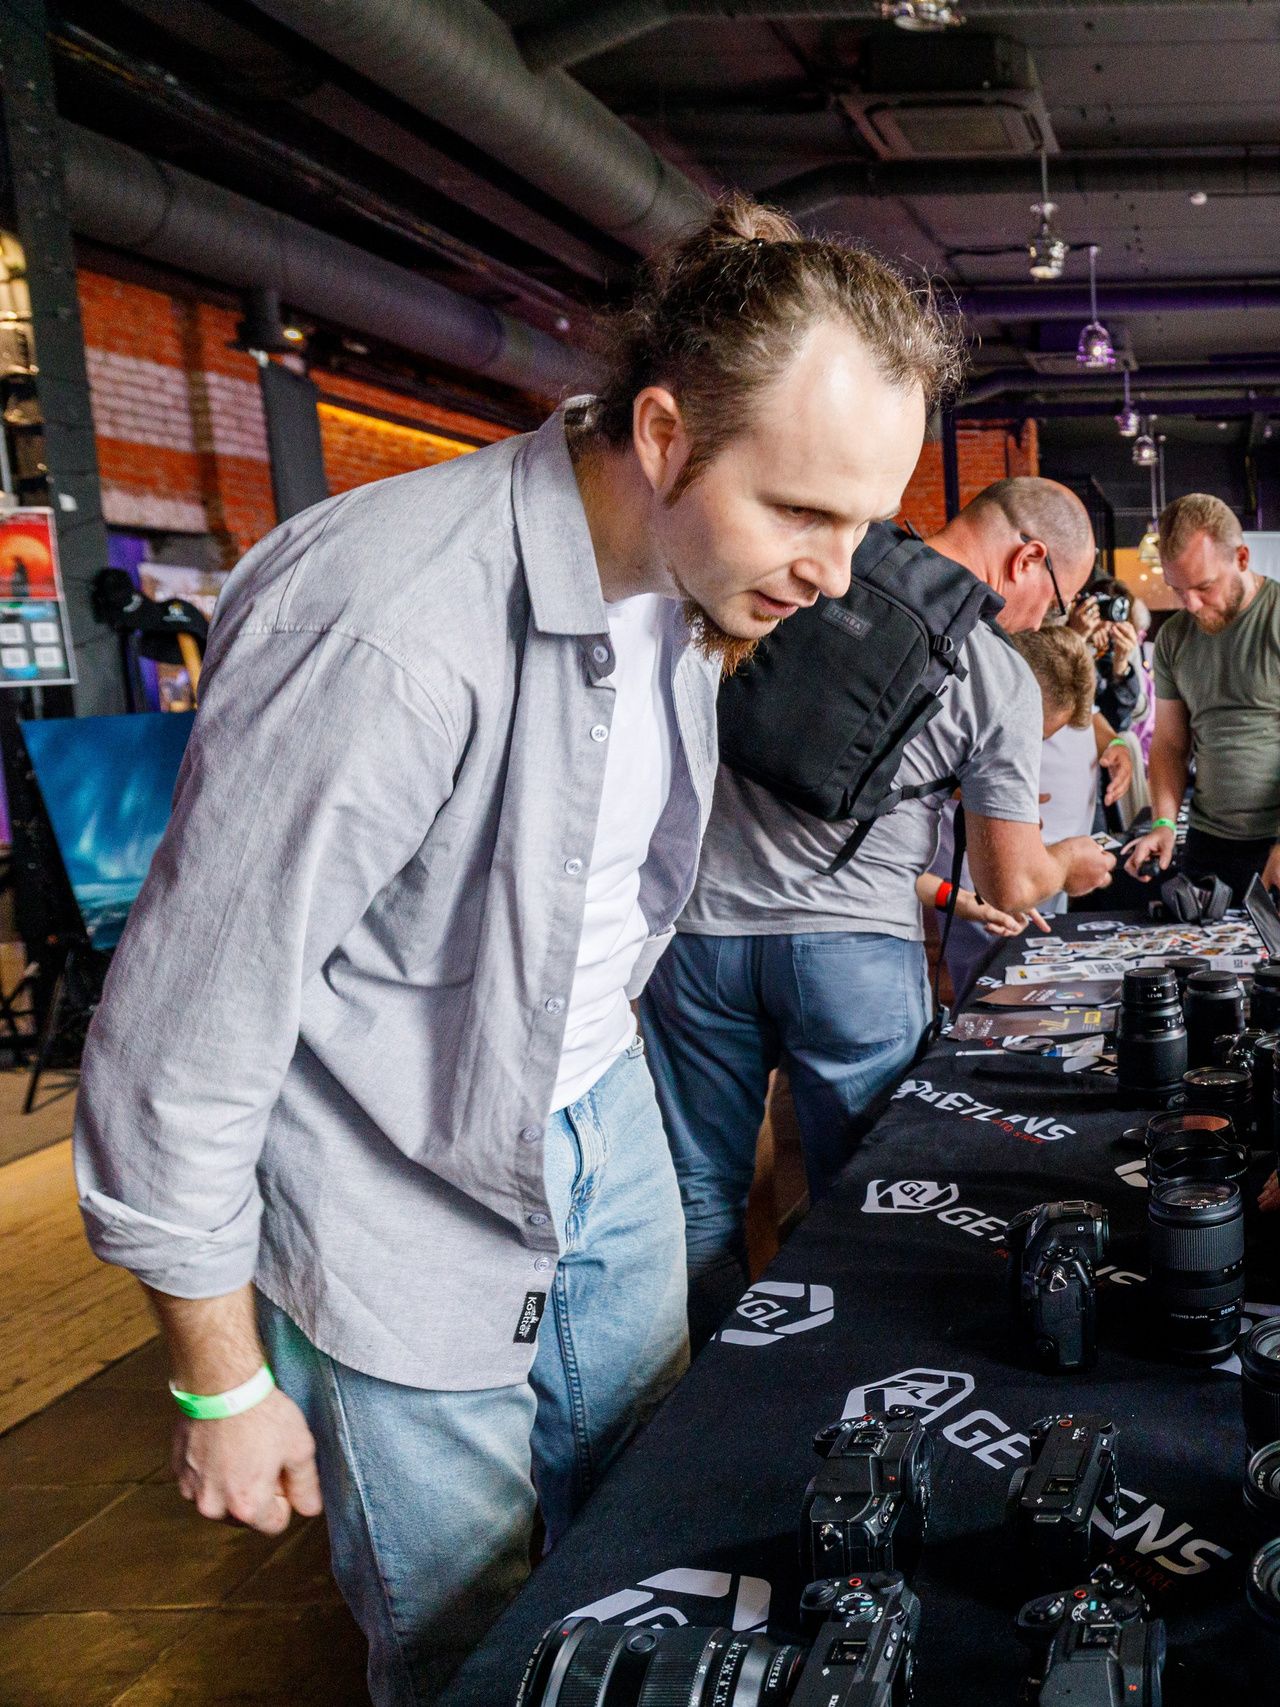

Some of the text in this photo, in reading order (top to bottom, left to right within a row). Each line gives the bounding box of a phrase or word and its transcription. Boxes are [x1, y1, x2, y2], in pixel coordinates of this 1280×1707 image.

[1220, 1305, 1235, 1315] DEMO
[699, 1665, 706, 1675] 35
[769, 1677, 776, 1688] FE
